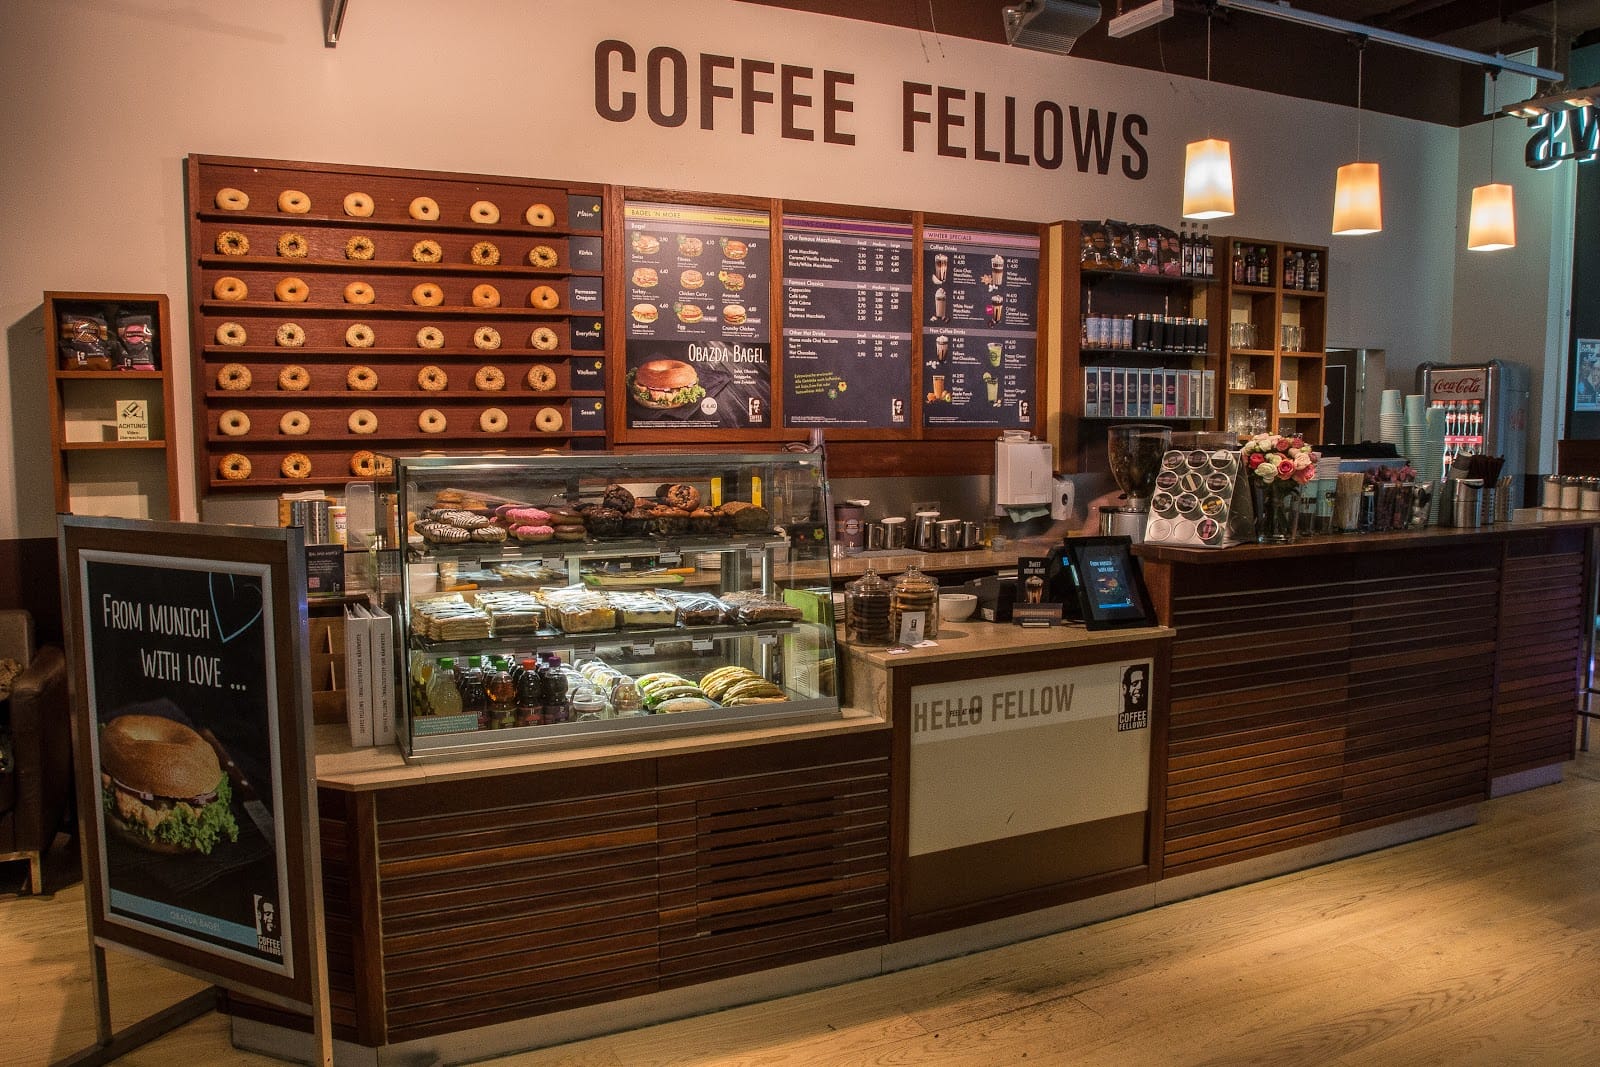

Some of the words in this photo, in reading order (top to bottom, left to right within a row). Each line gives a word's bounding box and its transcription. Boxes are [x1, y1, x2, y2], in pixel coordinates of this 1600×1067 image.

[595, 40, 856, 146] COFFEE
[902, 80, 1149, 180] FELLOWS
[577, 210, 594, 218] Plain
[688, 344, 729, 362] OBAZDA
[733, 344, 764, 363] BAGEL
[1433, 376, 1482, 394] Coca-Cola
[103, 594, 142, 631] FROM
[150, 604, 210, 639] MUNICH
[141, 648, 180, 682] WITH
[187, 654, 222, 688] LOVE
[914, 695, 982, 733] HELLO
[992, 683, 1075, 722] FELLOW
[1119, 710, 1146, 724] COFFEE
[1119, 720, 1146, 730] FELLOWS
[258, 936, 280, 949] COFFEE
